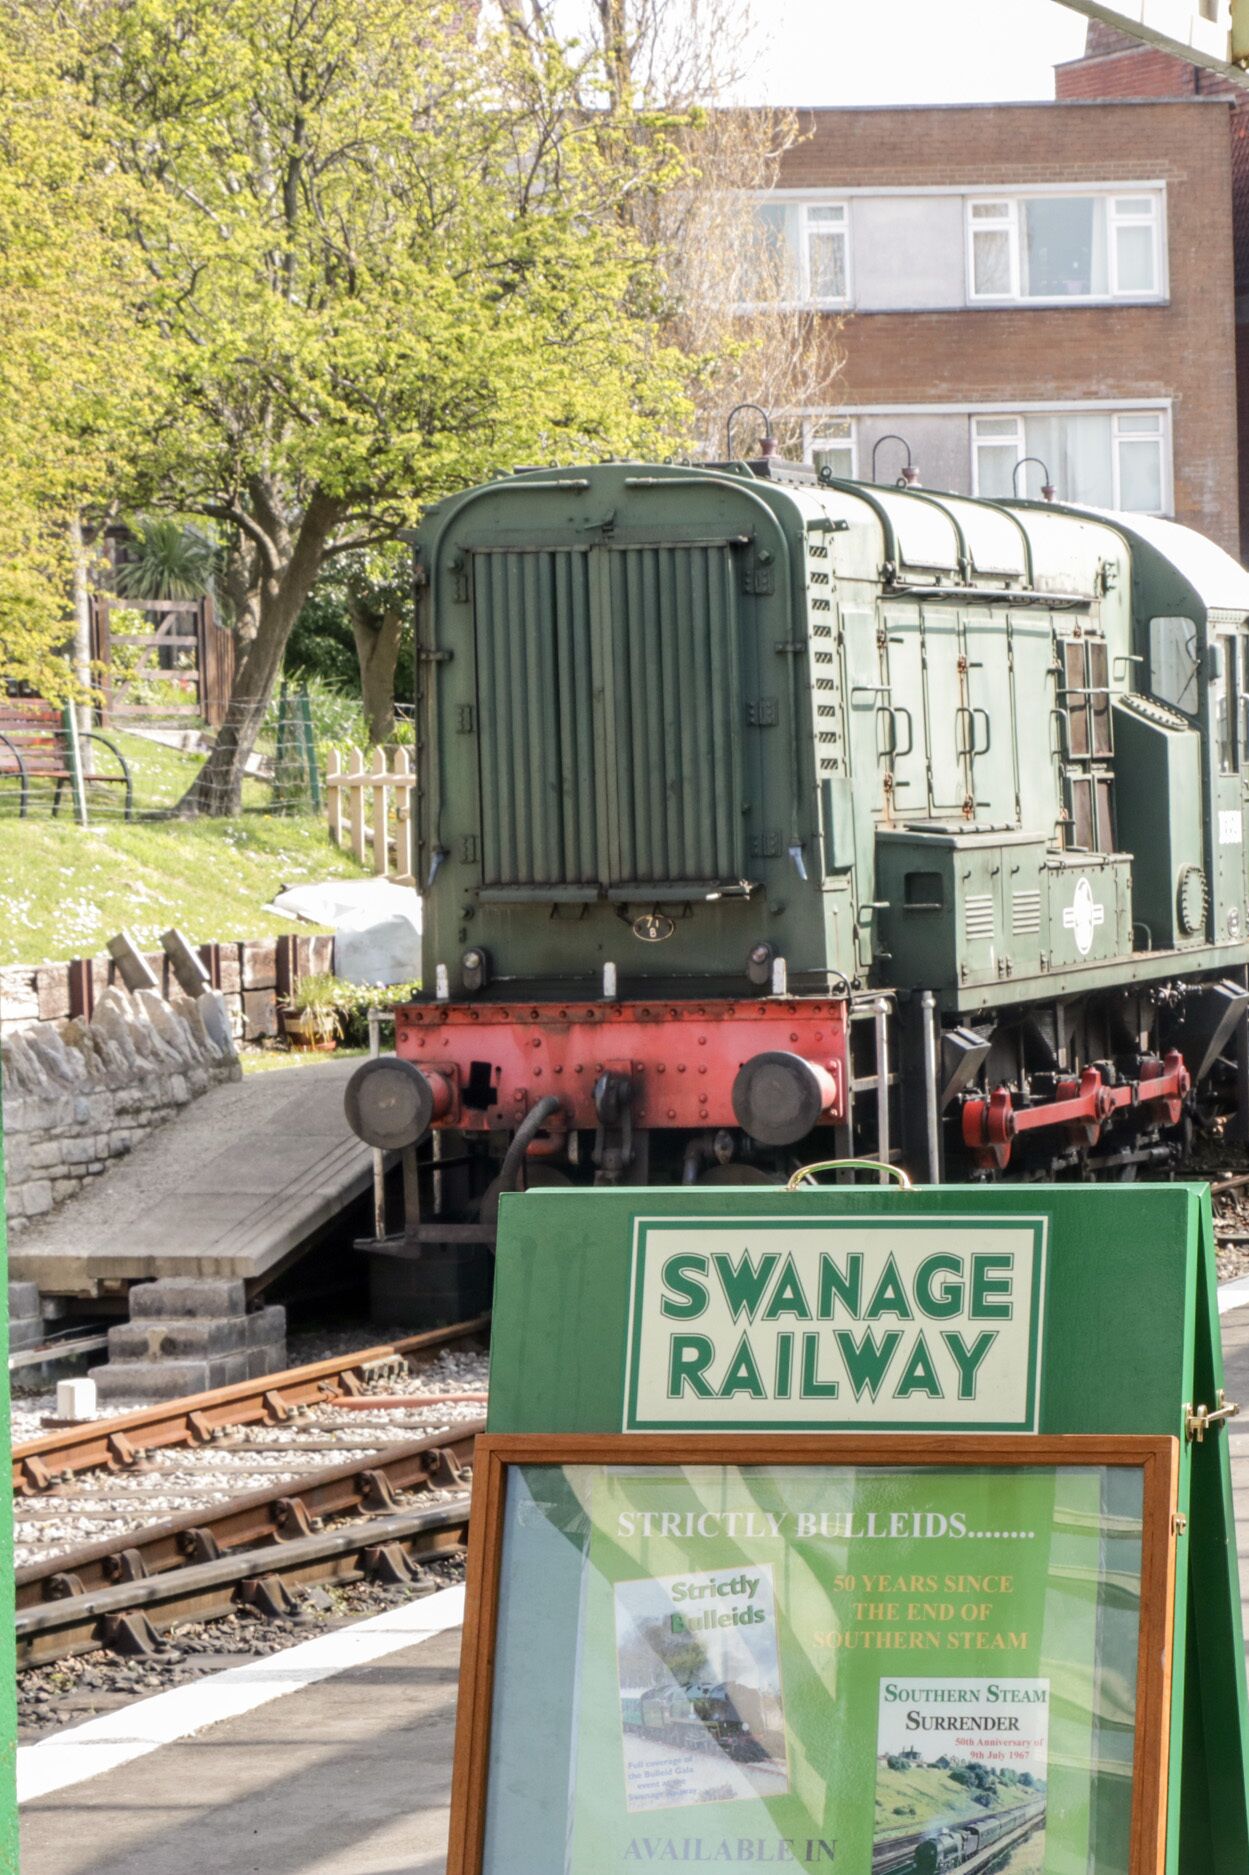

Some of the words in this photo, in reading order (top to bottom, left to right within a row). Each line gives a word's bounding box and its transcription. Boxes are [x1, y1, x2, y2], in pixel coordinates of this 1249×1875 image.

[659, 1247, 1015, 1325] SWANAGE
[666, 1326, 1000, 1404] RAILWAY
[617, 1511, 785, 1538] STRICTLY
[672, 1574, 760, 1602] Strictly
[833, 1574, 856, 1593] 50
[863, 1574, 939, 1593] YEARS
[944, 1574, 1014, 1593] SINCE
[671, 1605, 766, 1634] Bulleids
[853, 1602, 900, 1621] THE
[907, 1602, 955, 1621] END
[960, 1602, 993, 1621] OF
[814, 1630, 942, 1650] SOUTHERN
[946, 1630, 1029, 1650] STEAM
[884, 1683, 981, 1703] SOUTHERN
[986, 1684, 1047, 1704] STEAM
[906, 1710, 1020, 1731] SURRENDER
[955, 1737, 974, 1746] 50th
[976, 1737, 1031, 1749] Anniversary
[1033, 1737, 1044, 1747] of
[646, 1758, 682, 1769] coverage
[969, 1751, 984, 1760] 9th
[987, 1751, 1005, 1761] July
[1008, 1751, 1030, 1760] 1967
[675, 1766, 694, 1775] Gala
[623, 1837, 794, 1862] AVAILABLE
[805, 1838, 838, 1862] IN
